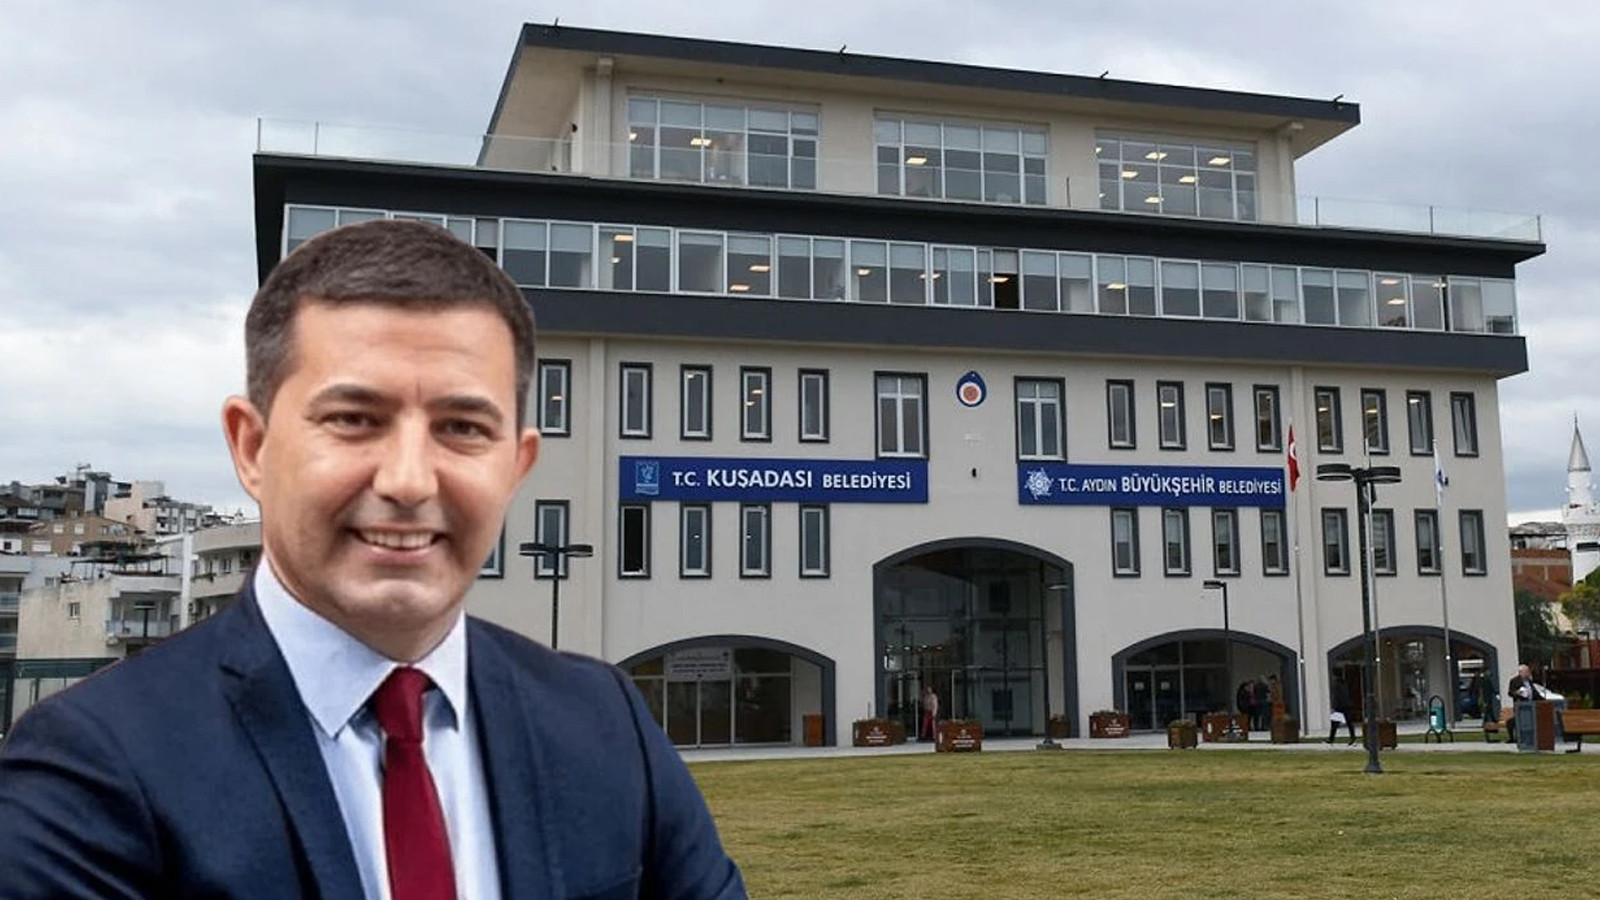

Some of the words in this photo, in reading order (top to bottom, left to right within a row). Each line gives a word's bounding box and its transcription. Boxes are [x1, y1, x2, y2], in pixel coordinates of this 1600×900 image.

[672, 471, 700, 487] T.C.
[707, 469, 812, 489] KUŞADASI
[823, 471, 911, 489] BELEDİYESİ
[1059, 478, 1080, 492] T.C.
[1082, 478, 1117, 492] AYDIN
[1121, 473, 1215, 496] BÜYÜKŞEHİR
[1219, 478, 1282, 495] BELEDİYESİ
